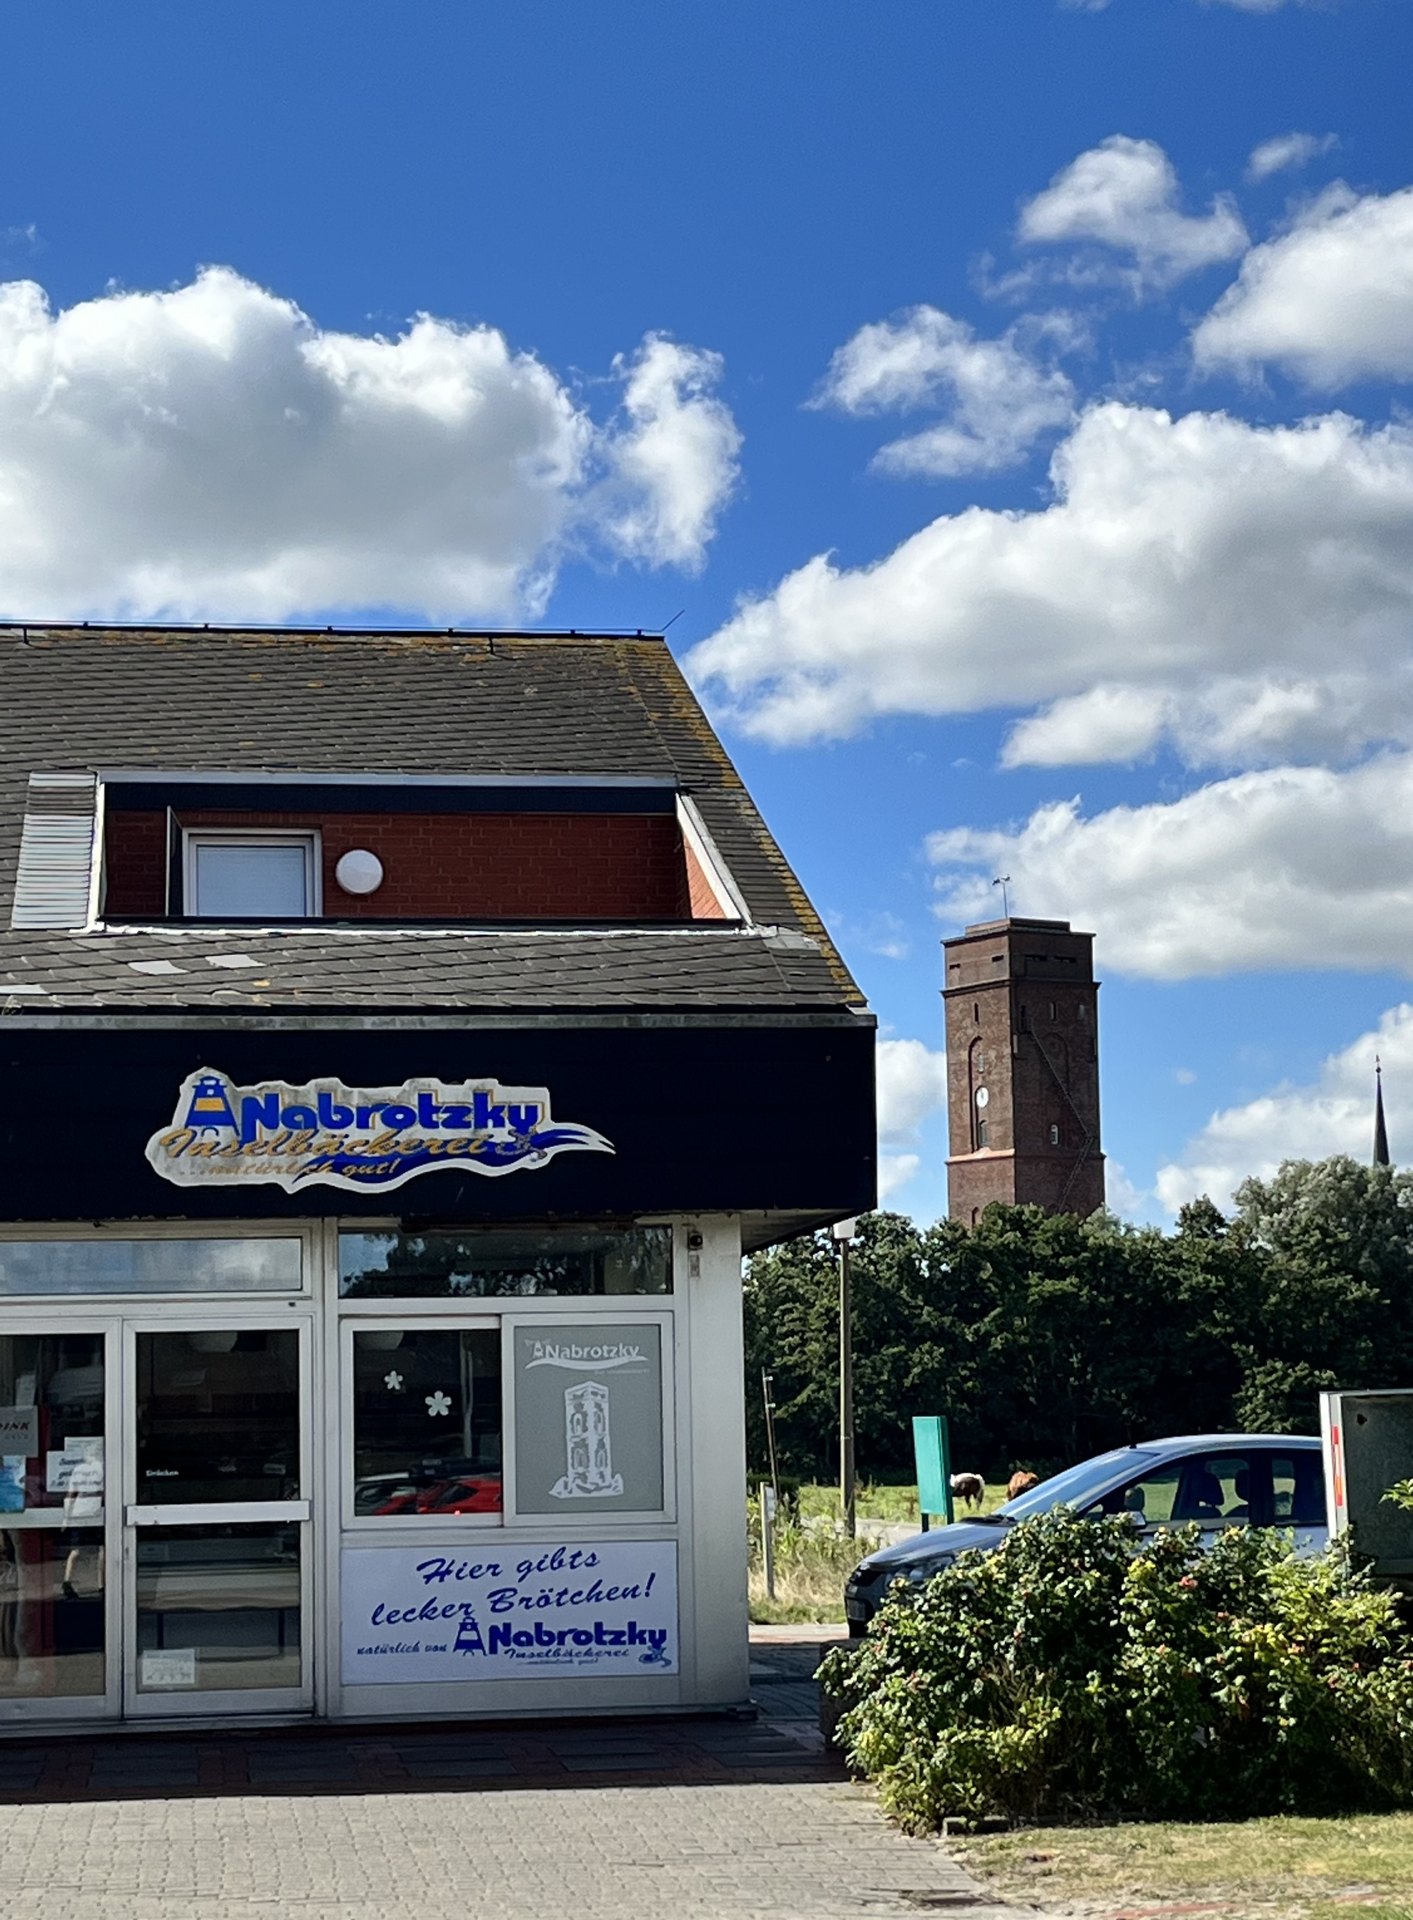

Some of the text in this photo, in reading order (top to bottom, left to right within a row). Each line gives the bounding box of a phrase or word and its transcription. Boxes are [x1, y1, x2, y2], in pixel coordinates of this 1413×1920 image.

[241, 1091, 541, 1144] Nabrotzky
[160, 1128, 488, 1158] Inselbäckerei
[342, 1158, 401, 1177] gut!
[546, 1343, 640, 1358] Nabrotzky
[416, 1546, 601, 1585] Hier gibts
[371, 1573, 656, 1626] lecker Brötchen!
[357, 1621, 667, 1655] natürlich von Nabrotzky
[504, 1647, 630, 1659] Inselbäckerei
